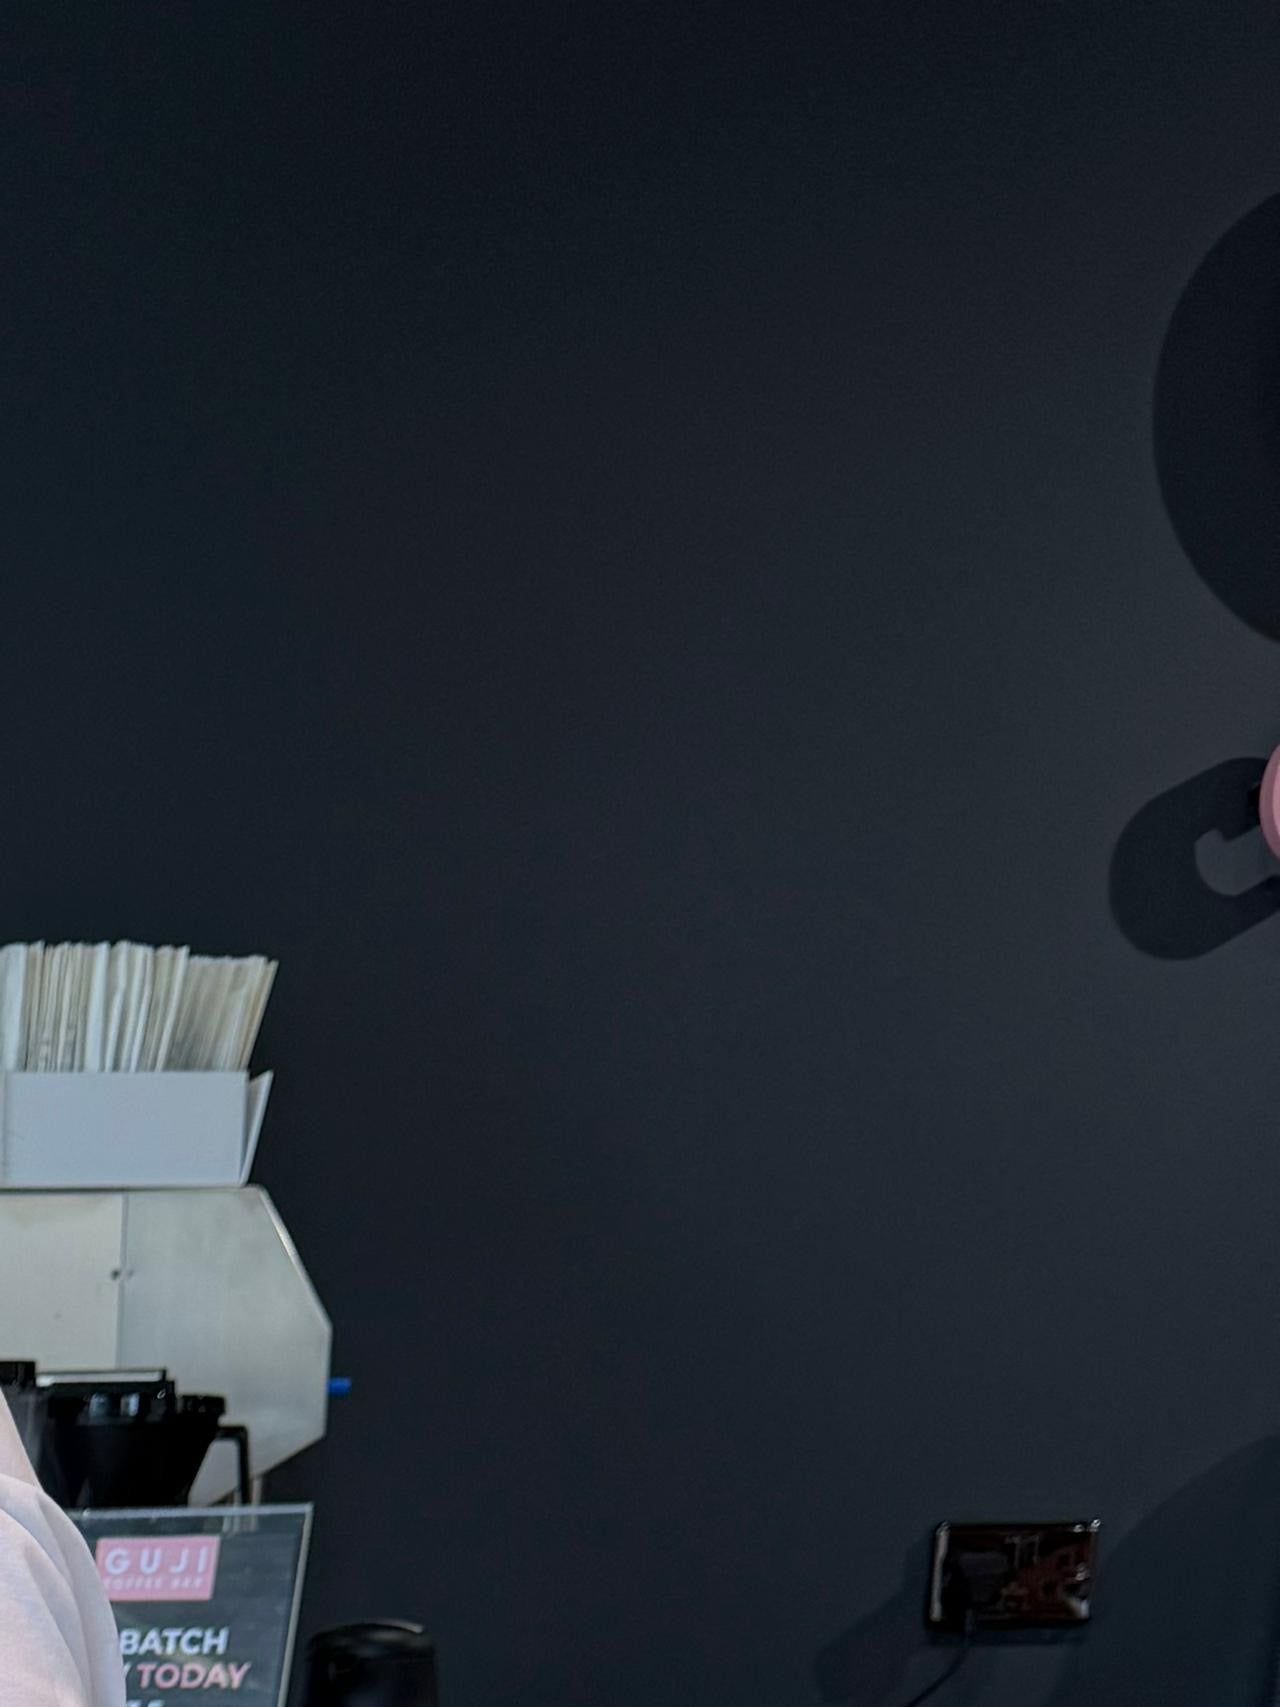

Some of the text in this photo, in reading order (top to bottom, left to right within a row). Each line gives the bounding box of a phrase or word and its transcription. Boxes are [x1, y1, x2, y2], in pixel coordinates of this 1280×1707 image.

[104, 1546, 209, 1575] GUJI
[119, 1627, 229, 1656] BATCH
[137, 1661, 252, 1690] TODAY
